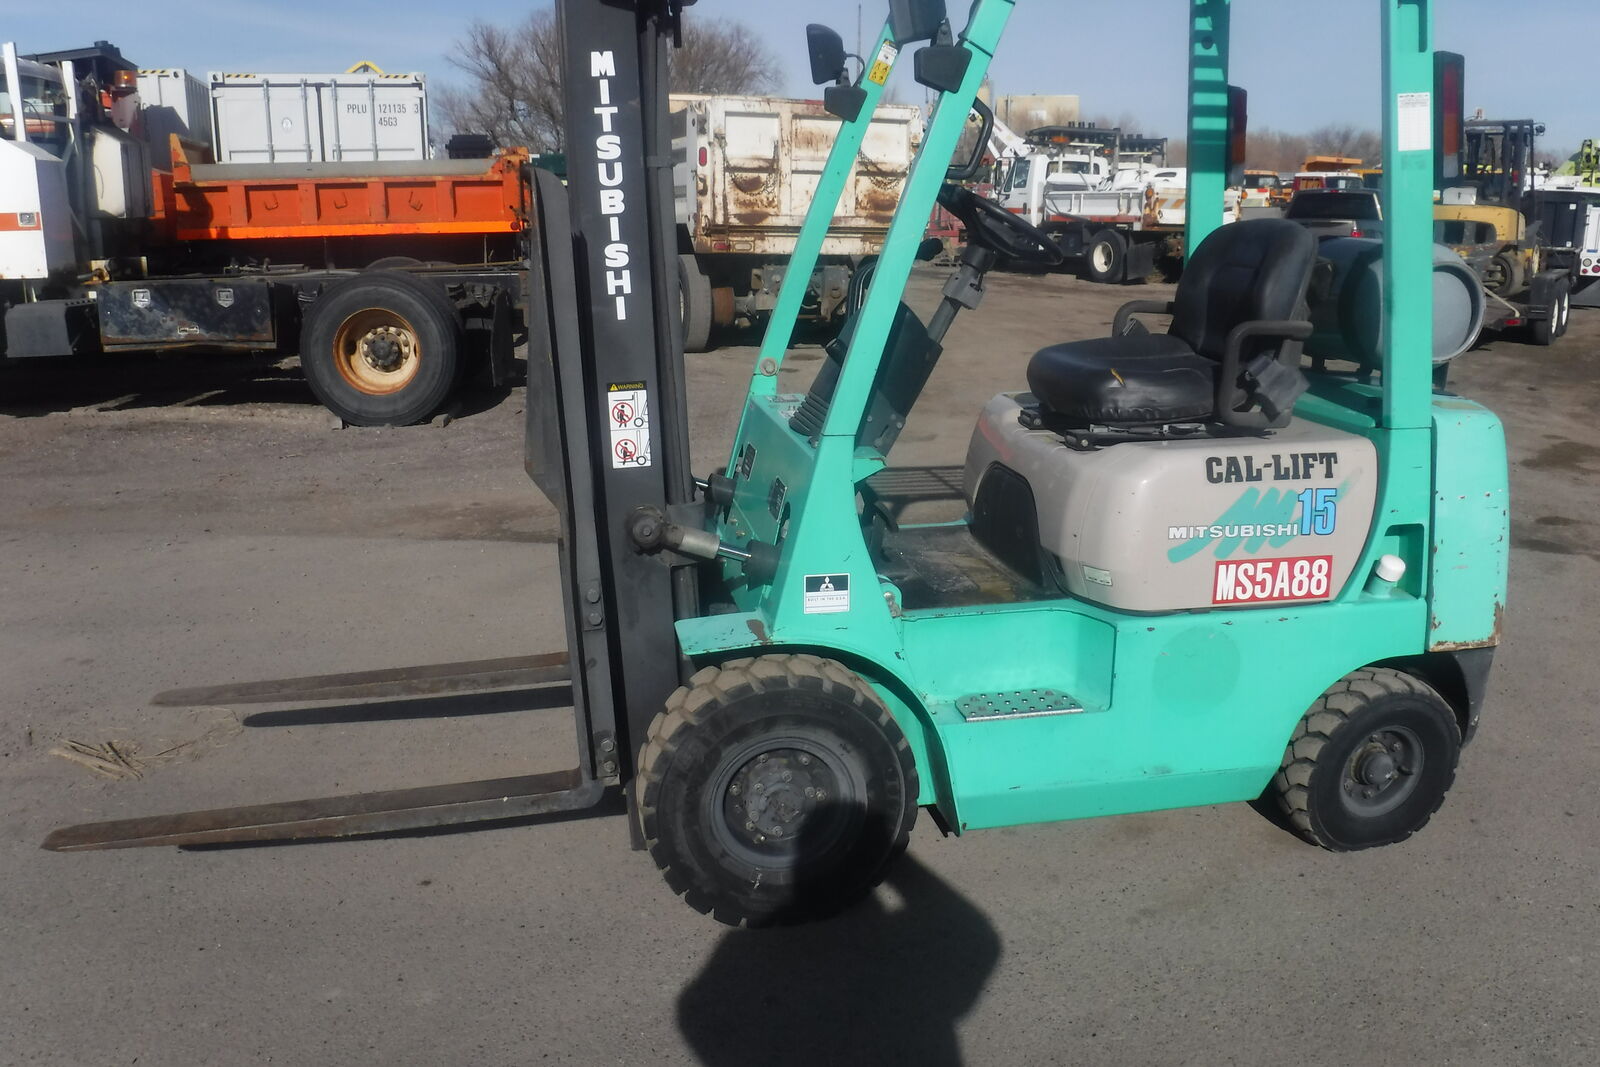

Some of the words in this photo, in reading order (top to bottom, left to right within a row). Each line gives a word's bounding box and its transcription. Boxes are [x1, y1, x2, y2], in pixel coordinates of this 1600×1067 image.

[347, 104, 367, 113] PPLU
[378, 104, 406, 113] 121135
[378, 117, 397, 126] 45G3
[591, 51, 631, 321] MITSUBISHI
[1205, 452, 1338, 484] CAL-LIFT
[1168, 523, 1298, 539] MITSUBISHI
[1297, 487, 1338, 536] 15
[1216, 559, 1329, 601] MS5A88
